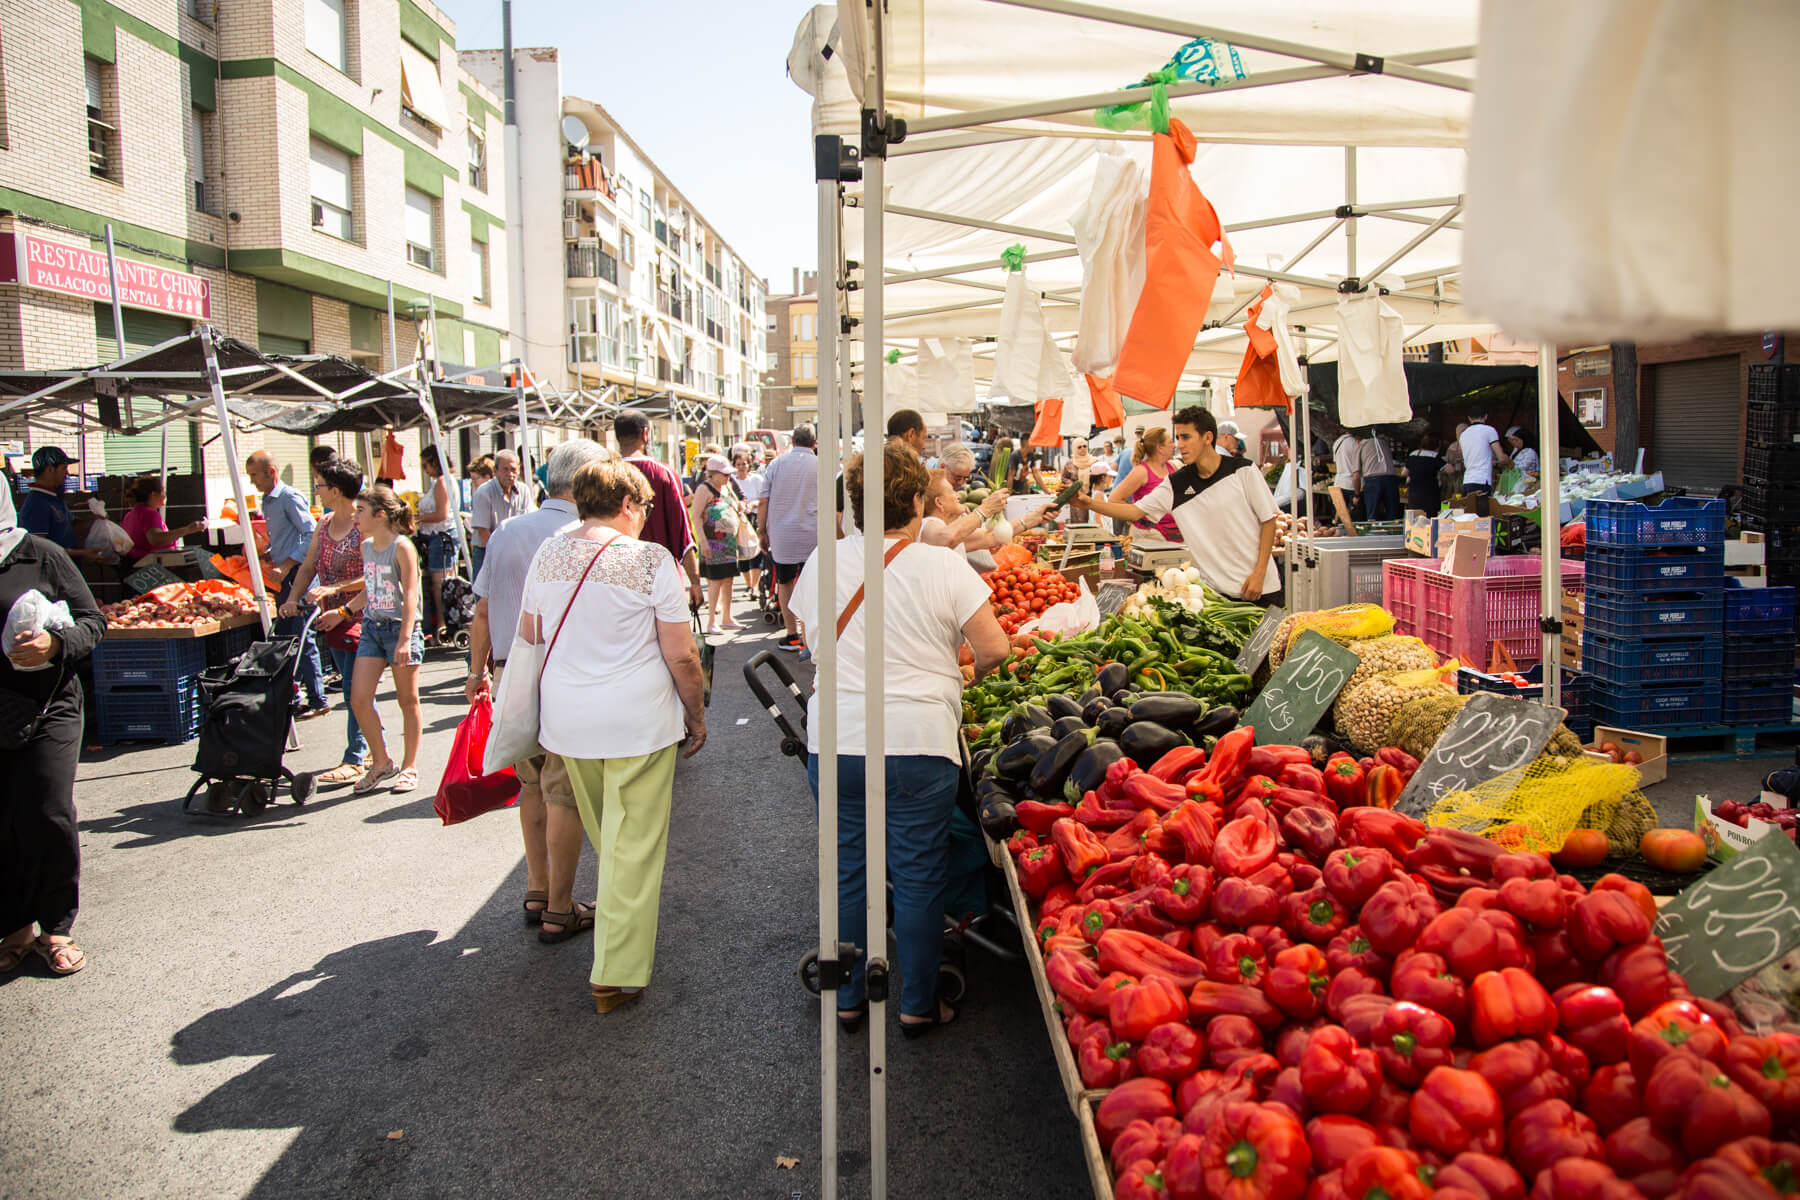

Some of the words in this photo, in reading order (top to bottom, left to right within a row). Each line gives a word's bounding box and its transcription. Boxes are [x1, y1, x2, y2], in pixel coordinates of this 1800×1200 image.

[37, 269, 96, 294] PALACIO
[160, 272, 207, 299] CHINO
[1287, 646, 1344, 705] 1'50
[1436, 711, 1543, 772] 2'25
